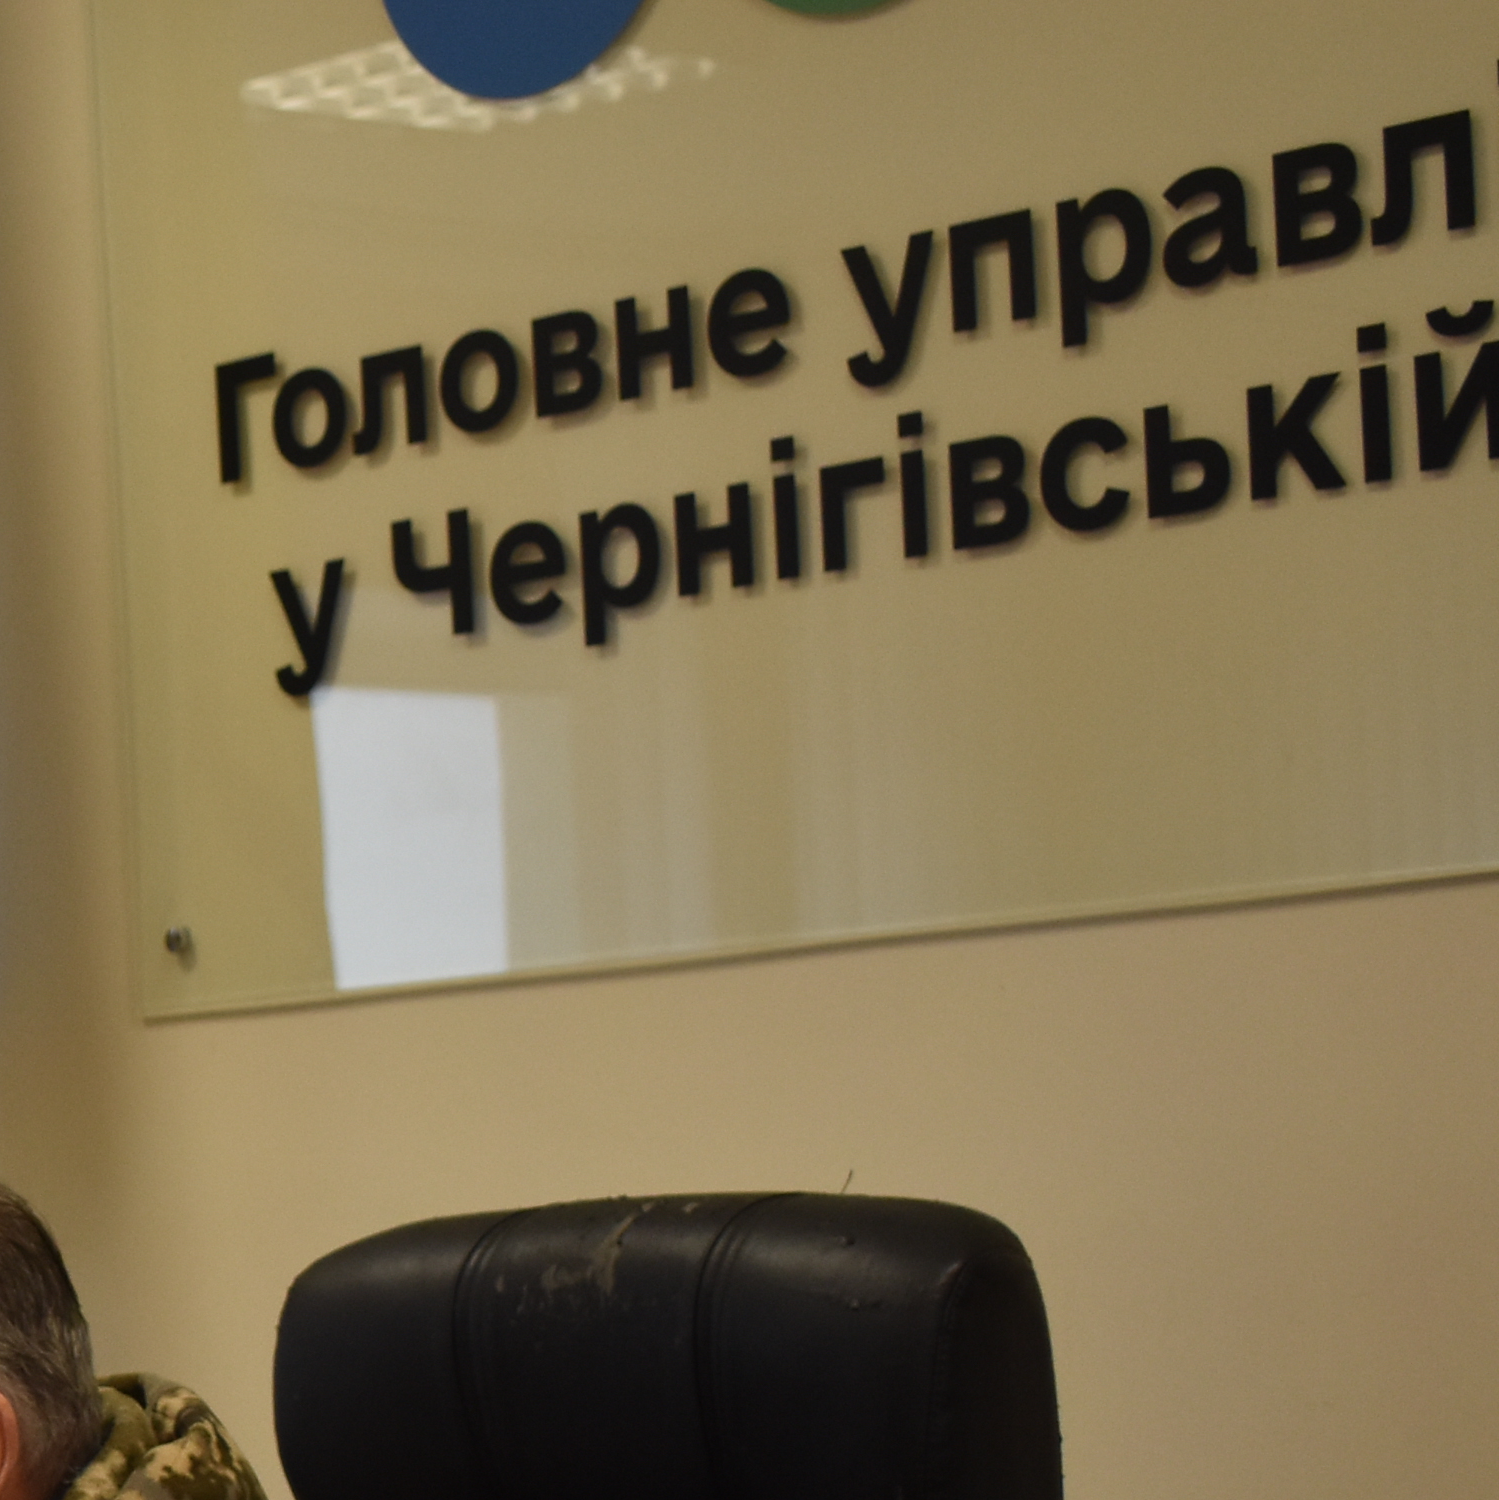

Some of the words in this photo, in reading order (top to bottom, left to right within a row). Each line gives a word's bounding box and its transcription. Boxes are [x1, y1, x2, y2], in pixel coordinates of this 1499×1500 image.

[216, 268, 792, 484] Головне
[841, 108, 1478, 388] управл
[270, 558, 345, 699] у
[391, 299, 1499, 648] Чернігівській
